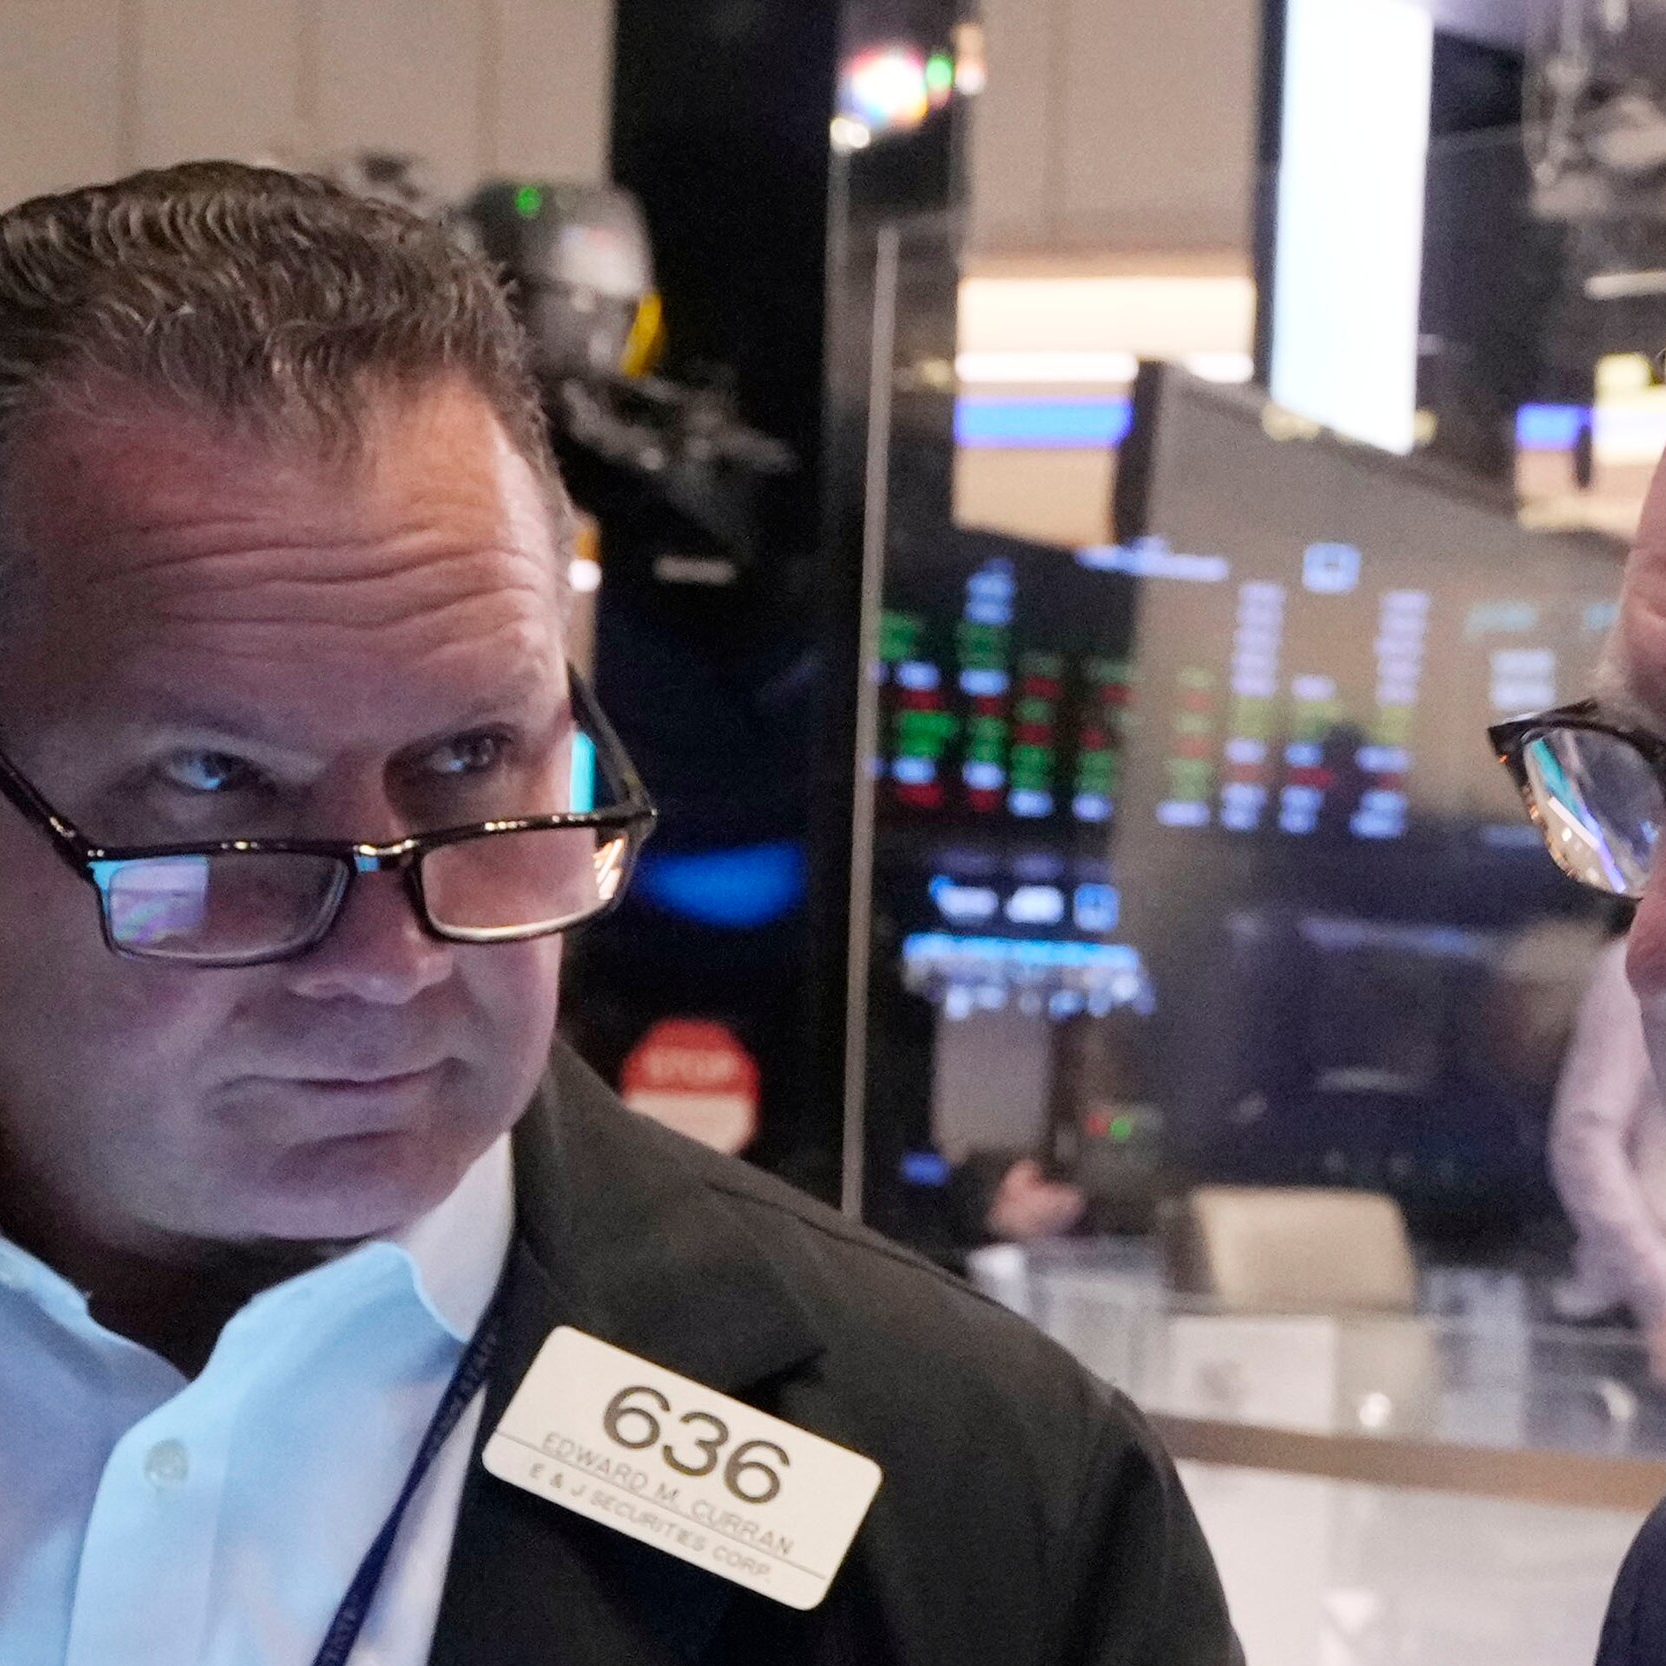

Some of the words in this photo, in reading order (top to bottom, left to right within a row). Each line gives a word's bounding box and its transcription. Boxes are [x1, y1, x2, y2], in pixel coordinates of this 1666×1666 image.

[542, 1431, 649, 1490] EDWARD
[691, 1499, 794, 1555] CURRAN
[603, 1385, 790, 1504] 636
